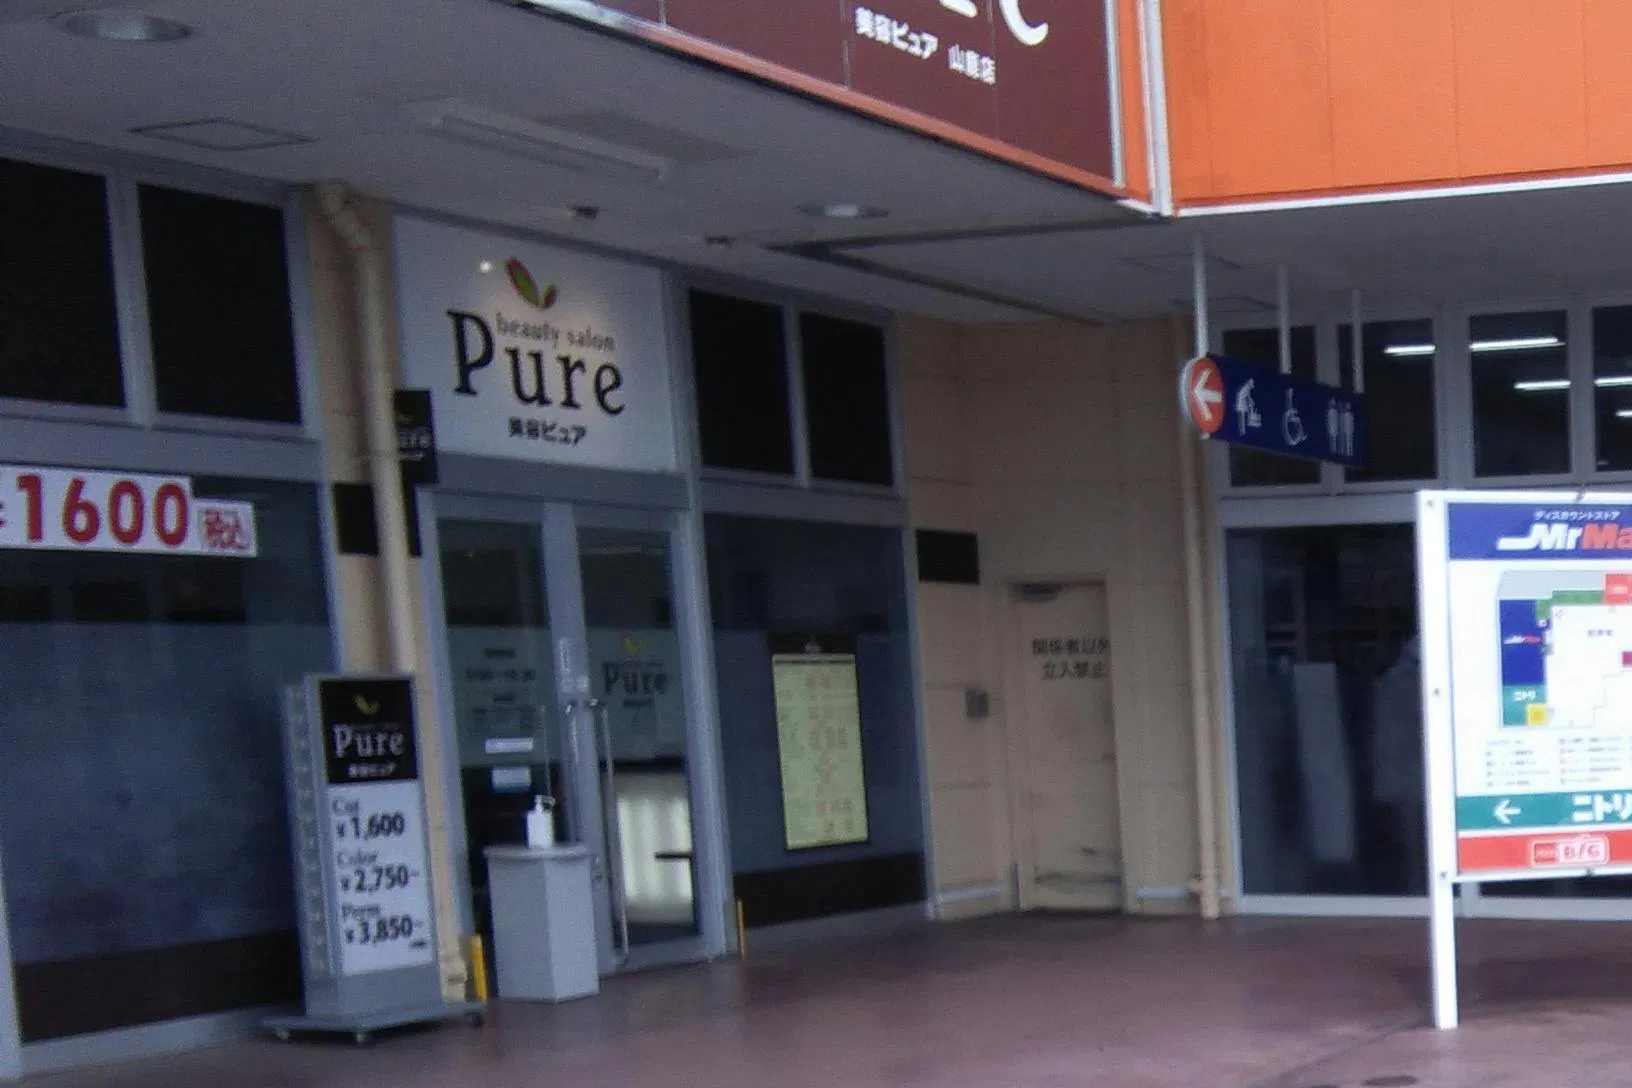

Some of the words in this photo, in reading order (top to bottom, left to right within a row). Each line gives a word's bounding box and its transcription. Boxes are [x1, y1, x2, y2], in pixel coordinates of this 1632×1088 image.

[496, 312, 561, 349] beauty
[566, 325, 618, 352] salon
[446, 309, 625, 416] Pure
[0, 473, 189, 547] 1600
[1533, 510, 1621, 521] ディスカウントストア
[604, 660, 669, 695] Pure
[332, 723, 405, 759] Pure
